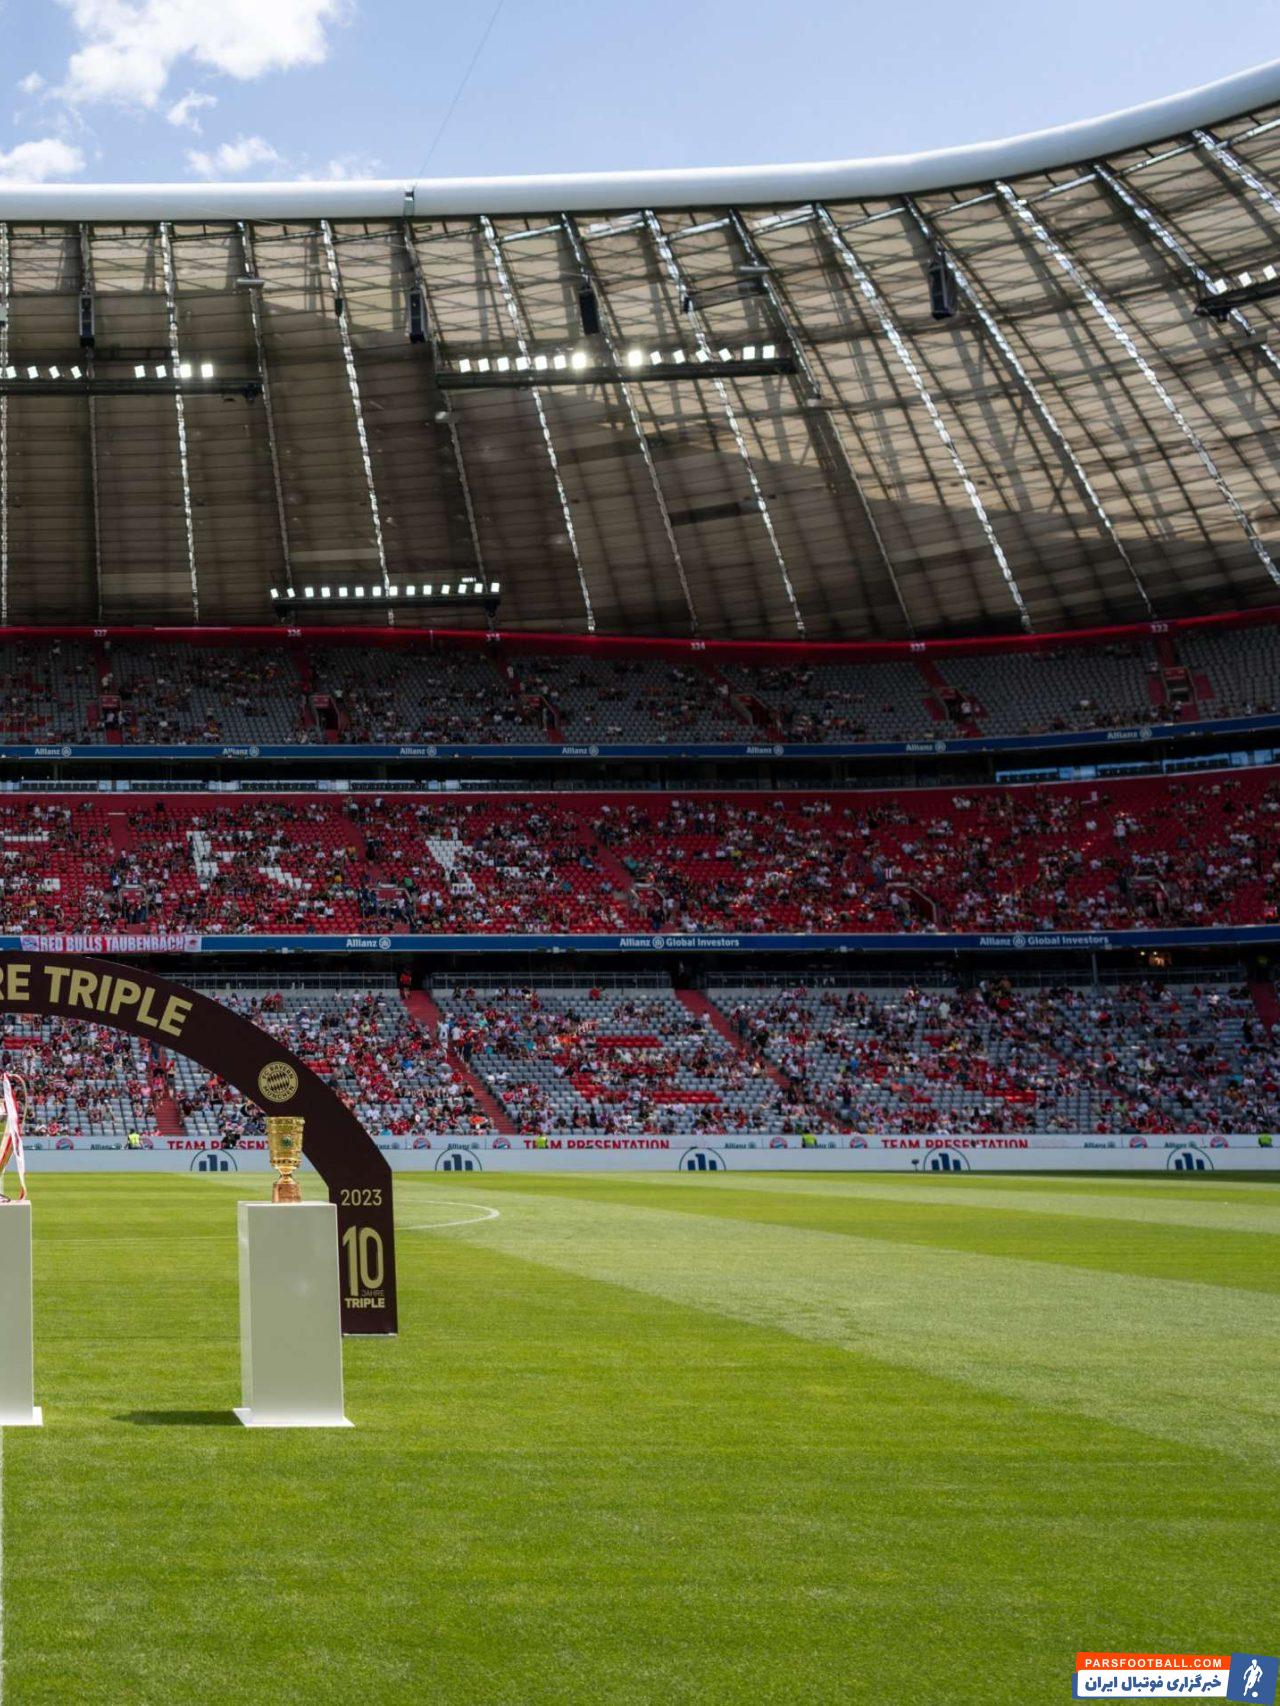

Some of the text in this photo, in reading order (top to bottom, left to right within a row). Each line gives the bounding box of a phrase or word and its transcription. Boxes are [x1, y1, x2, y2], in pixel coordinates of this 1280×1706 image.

[1107, 730, 1138, 740] Allianz
[34, 747, 60, 755] Allianz
[222, 746, 248, 755] Allianz
[399, 747, 426, 755] Allianz
[562, 746, 587, 754] Allianz
[746, 746, 772, 754] Allianz
[905, 743, 933, 752] Allianz
[39, 936, 63, 951] RED
[66, 936, 103, 951] BULLS
[346, 939, 378, 948] Allianz
[620, 938, 739, 947] Allianz Global Investors
[980, 935, 1109, 946] Allianz Global Investors
[43, 965, 194, 1037] TRIPLE
[167, 1141, 205, 1150] TEAM
[567, 1140, 669, 1149] PRESENTATION
[881, 1139, 920, 1148] TEAM
[340, 1189, 382, 1206] 2023
[342, 1225, 385, 1296] 10
[344, 1297, 385, 1308] TRIPLE
